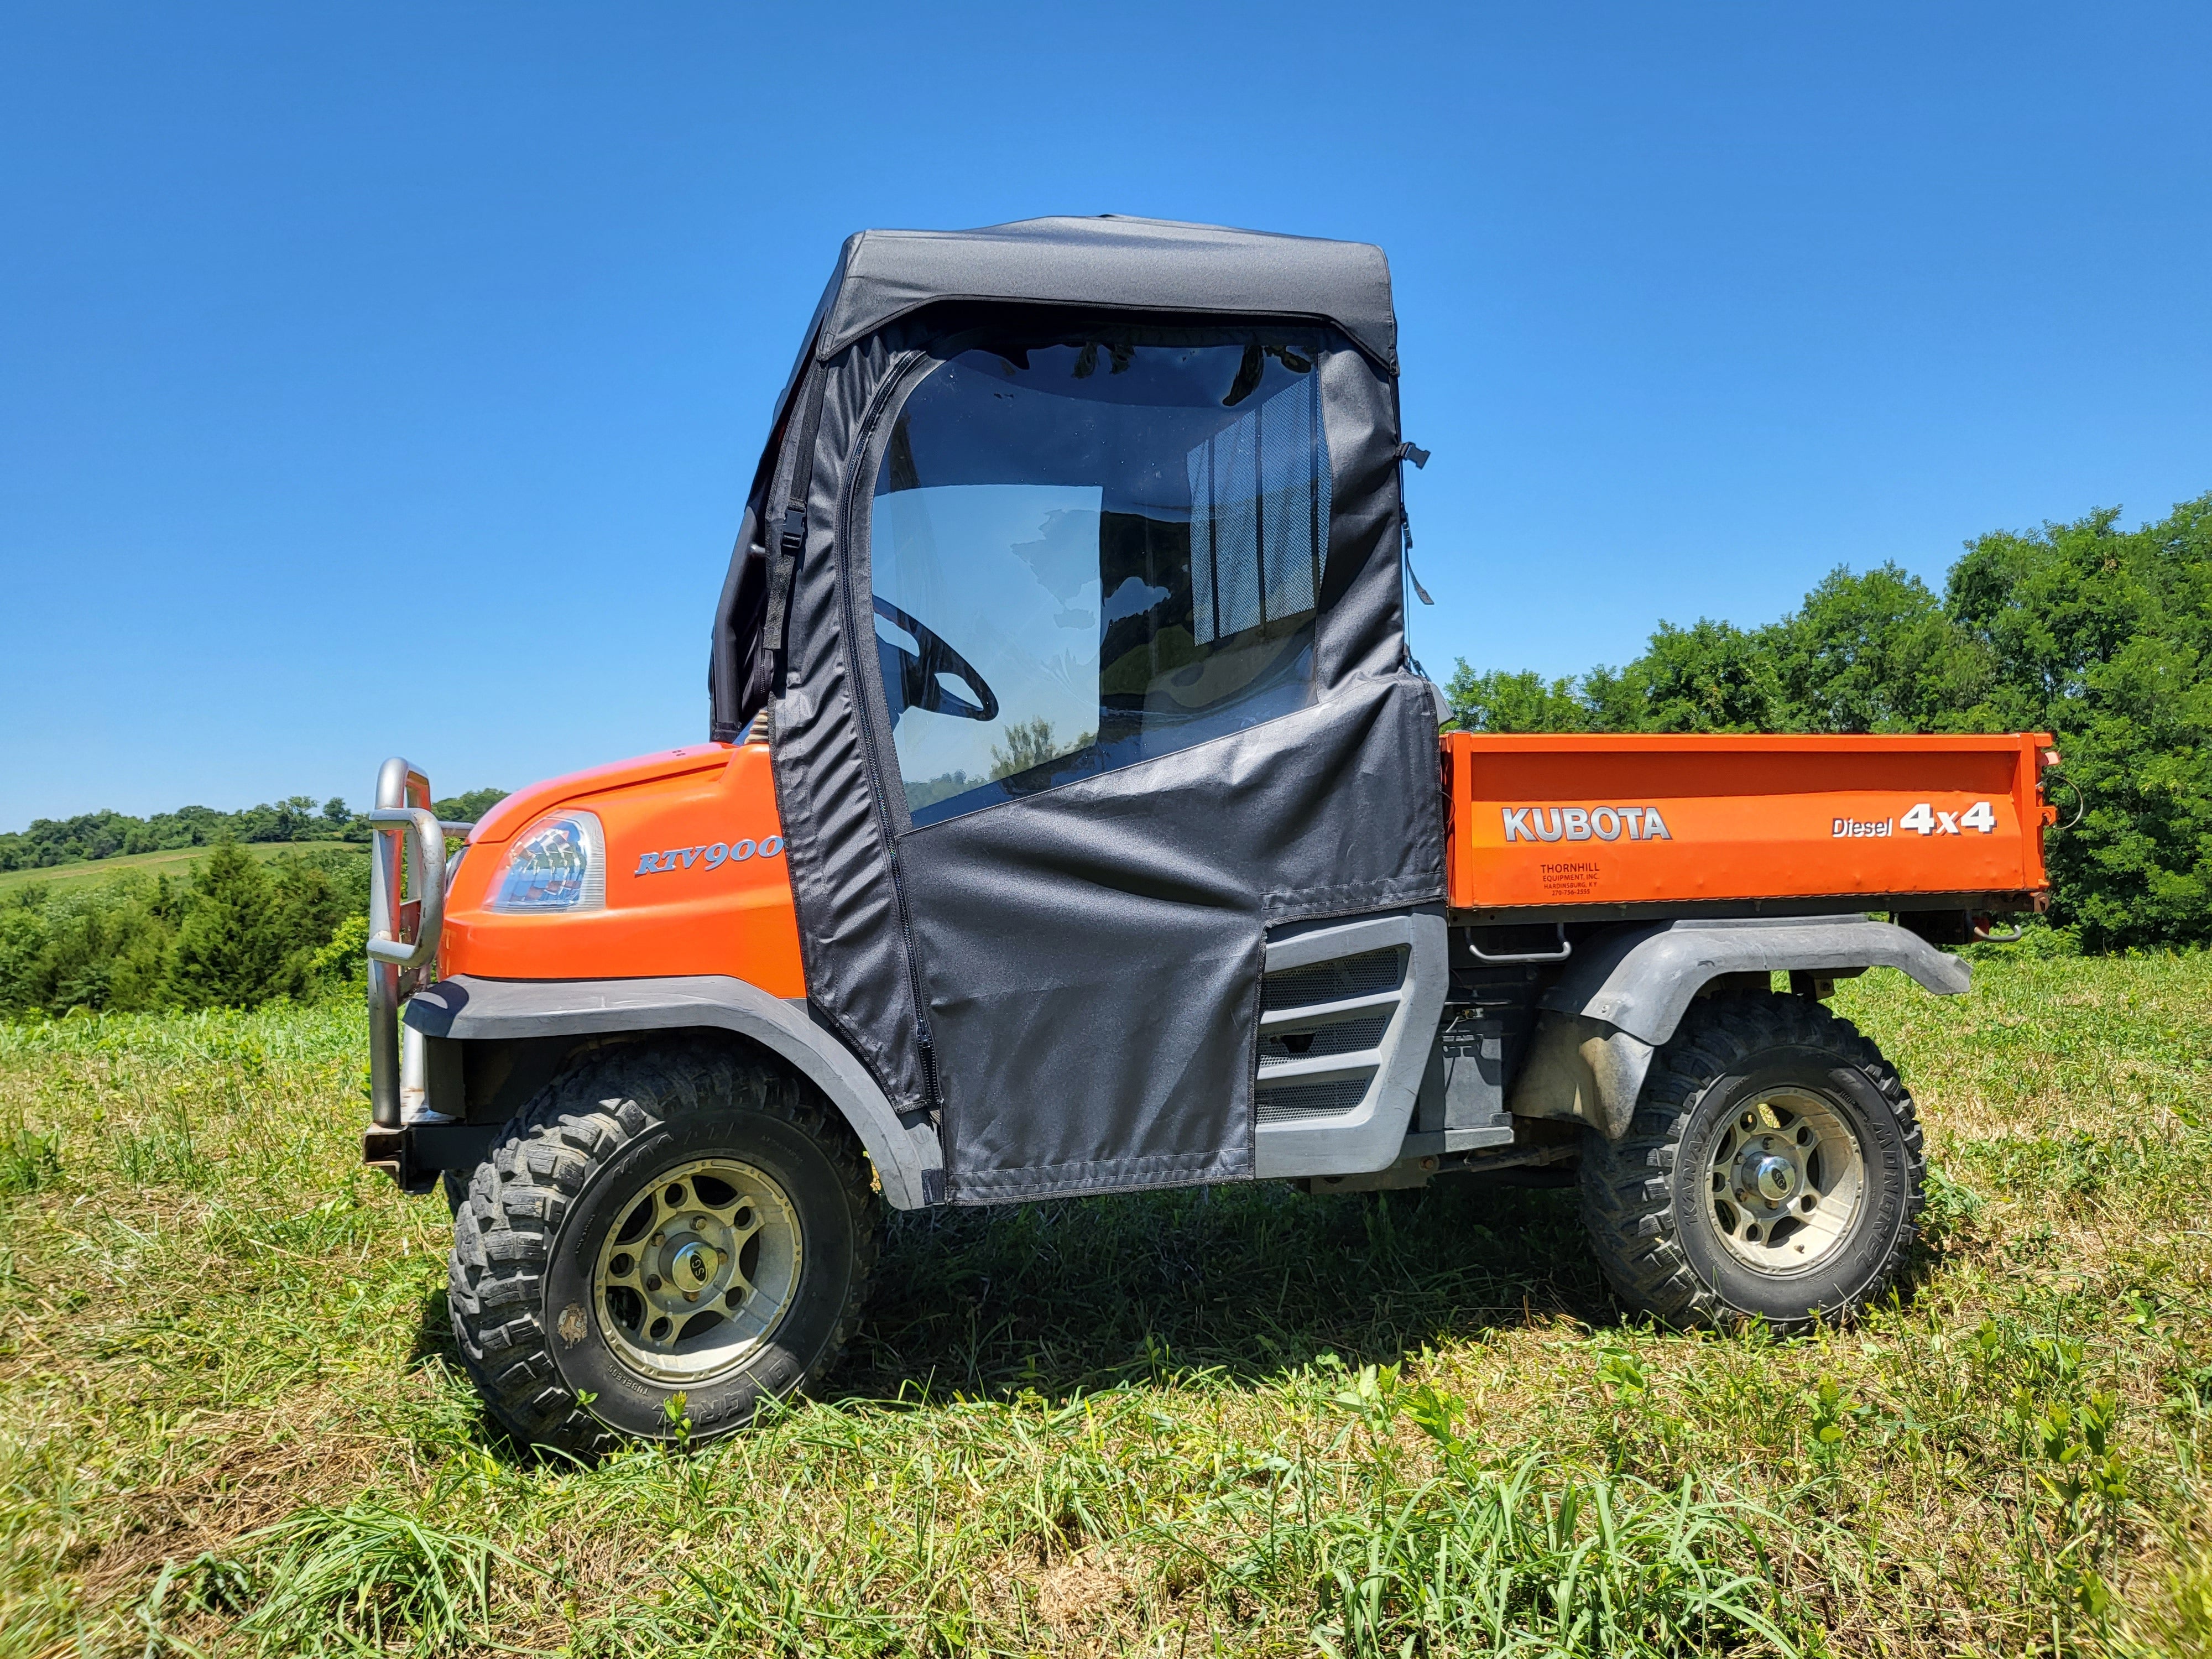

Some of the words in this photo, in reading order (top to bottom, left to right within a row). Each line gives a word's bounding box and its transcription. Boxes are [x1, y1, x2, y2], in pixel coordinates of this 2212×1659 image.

[1502, 806, 1672, 842] KUBOTA
[1832, 817, 1893, 838] Diesel
[1900, 801, 1997, 837] 4x4
[634, 835, 784, 877] RTV900
[1540, 863, 1599, 873] THORNHILL
[1854, 1120, 1901, 1269] MONGREL
[1807, 1261, 1845, 1285] TUBELESS
